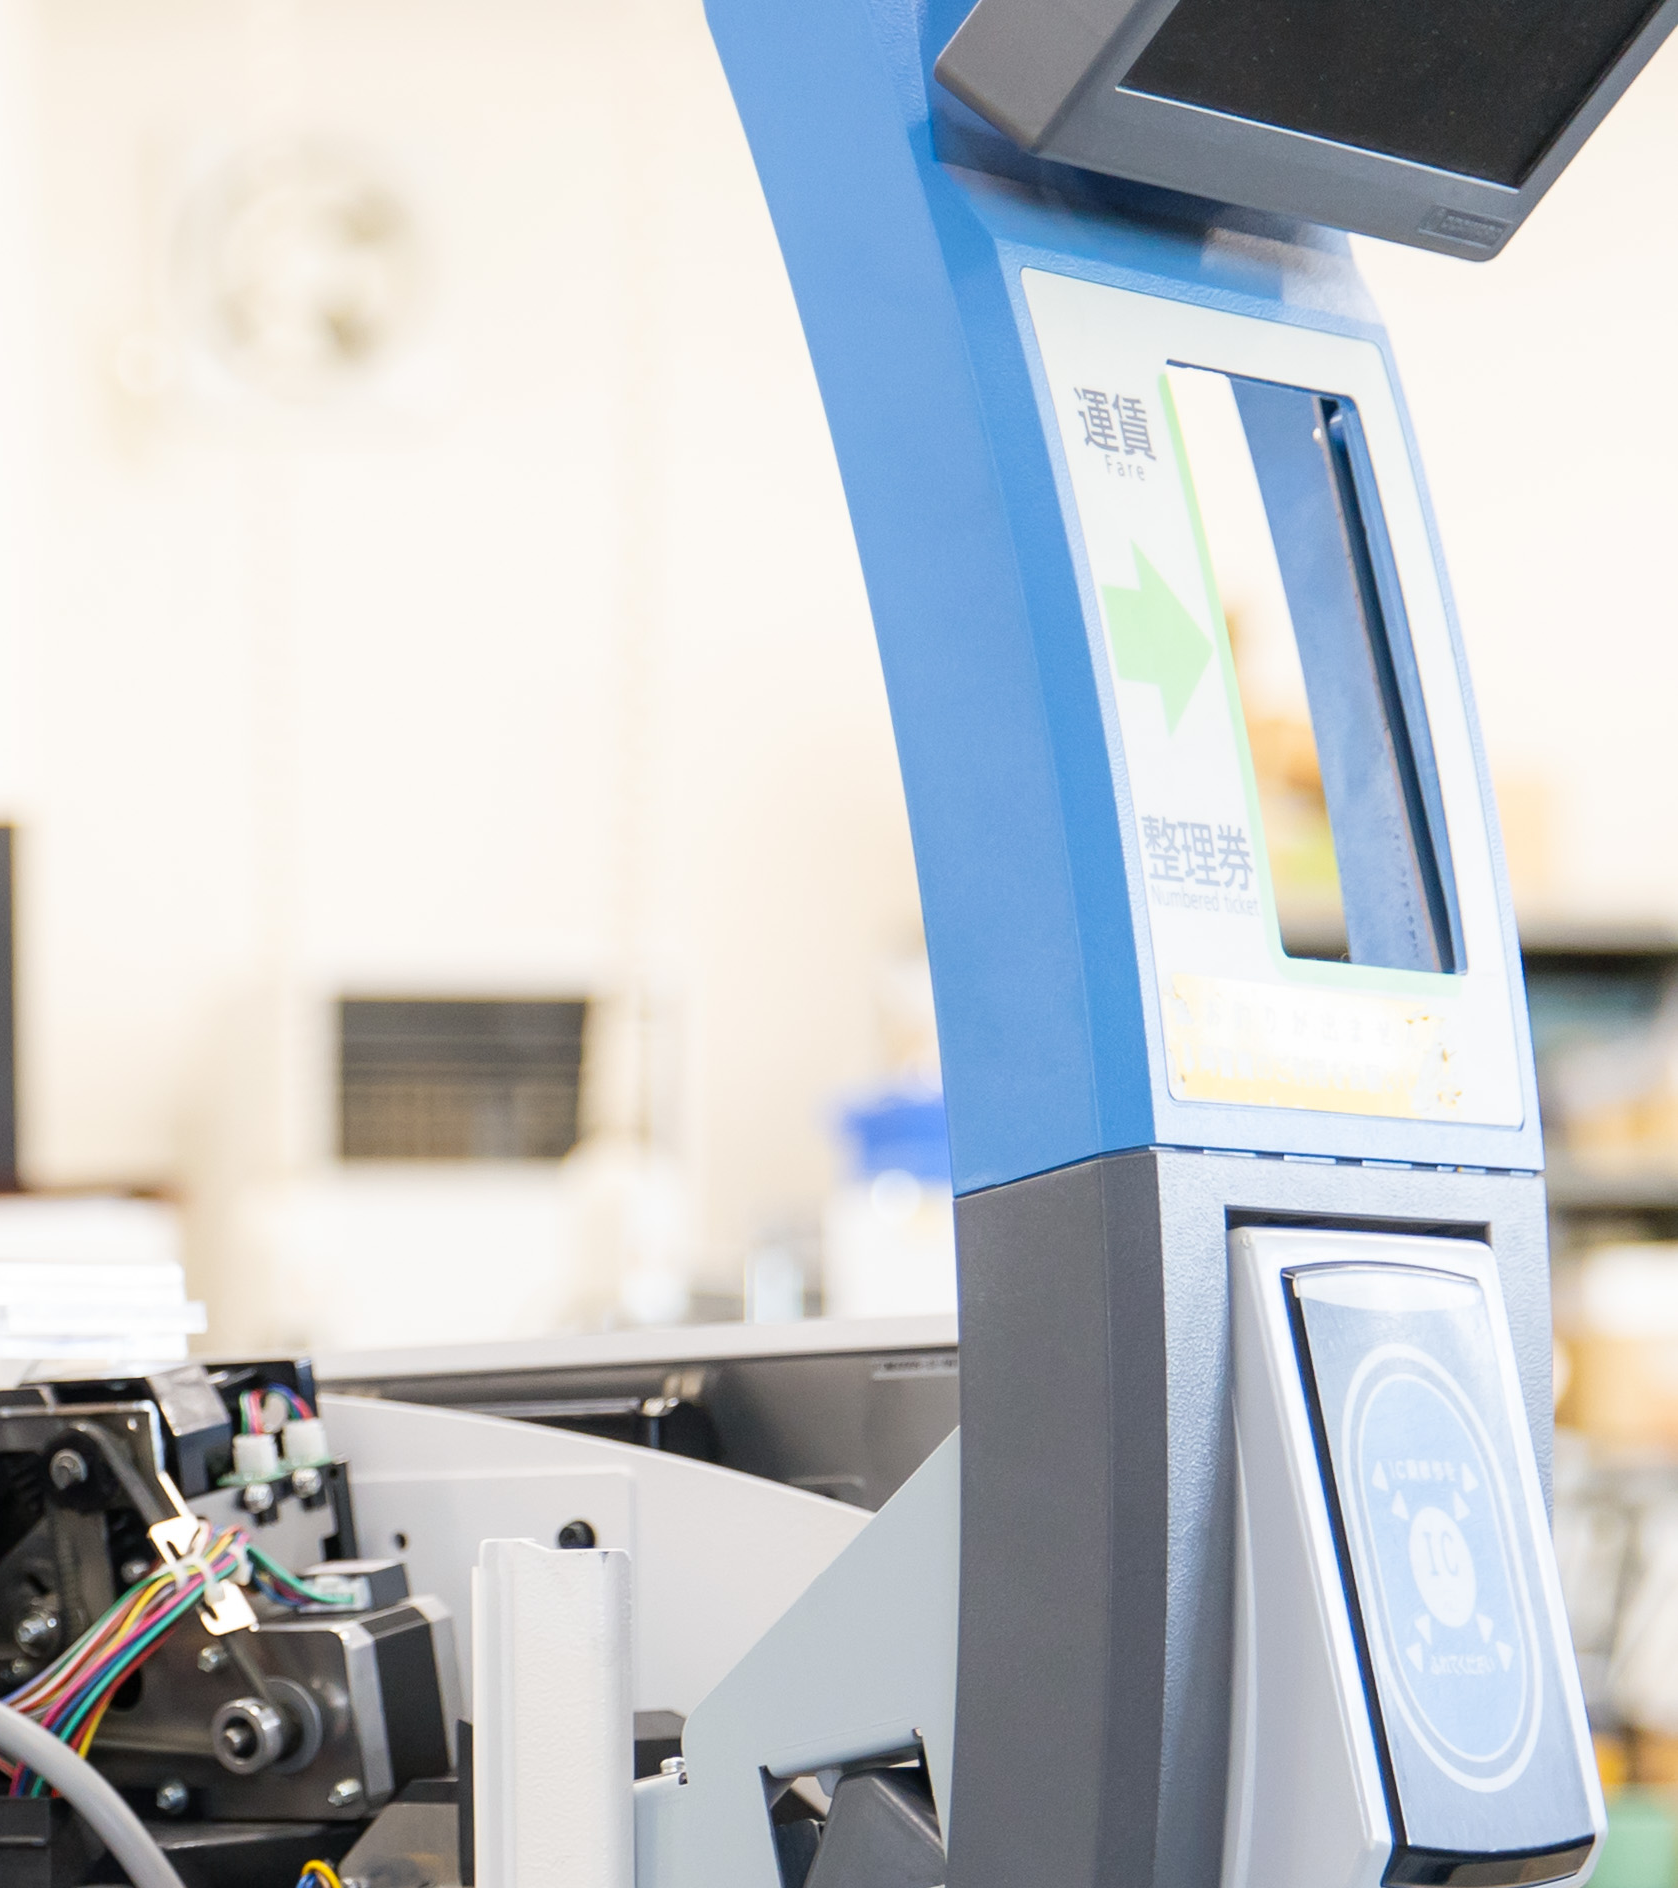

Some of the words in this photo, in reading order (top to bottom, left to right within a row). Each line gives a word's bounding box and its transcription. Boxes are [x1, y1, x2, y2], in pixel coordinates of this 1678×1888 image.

[1073, 387, 1157, 461] 運賃
[1104, 453, 1145, 481] Fare
[1140, 815, 1254, 891] 整理券
[1150, 883, 1220, 912] Numbered
[1223, 891, 1260, 917] ticket
[1422, 1530, 1459, 1577] IC
